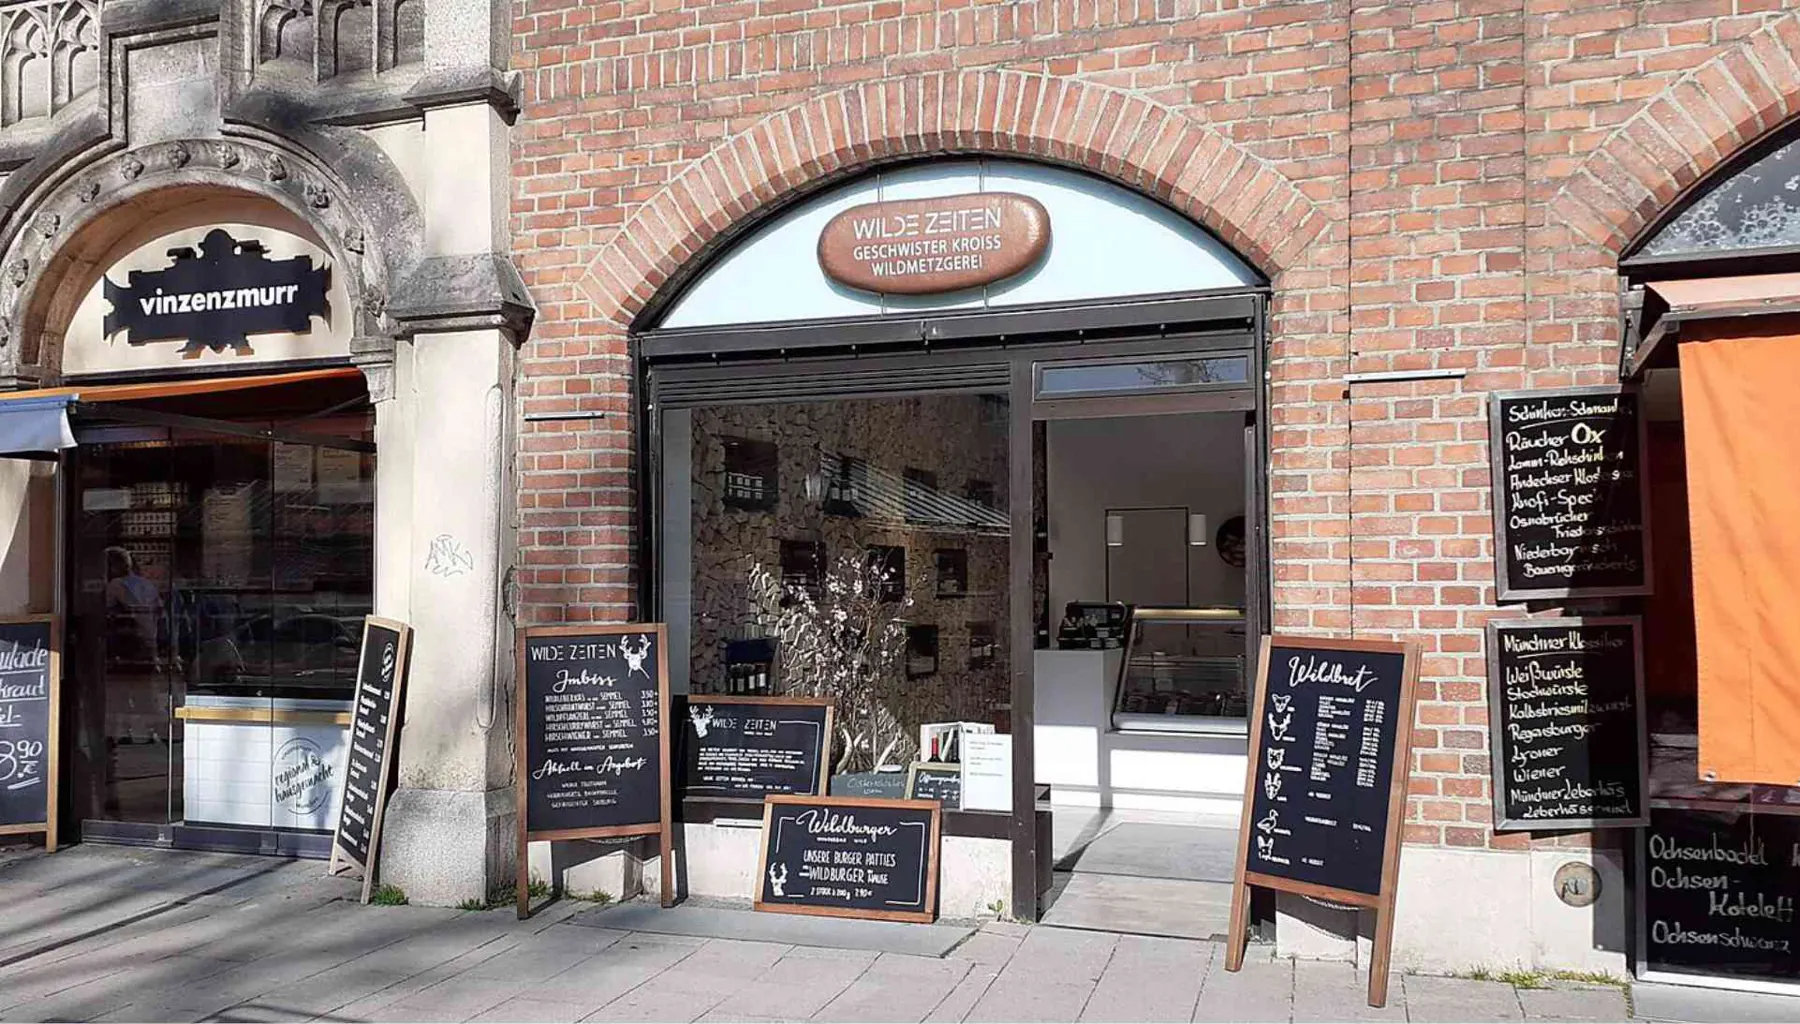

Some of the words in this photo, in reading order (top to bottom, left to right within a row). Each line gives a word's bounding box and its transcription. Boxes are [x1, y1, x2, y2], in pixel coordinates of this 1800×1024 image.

[853, 214, 920, 240] WILDE
[925, 207, 1001, 234] ZEITEN
[853, 240, 947, 261] GESCHWISTER
[952, 235, 1001, 252] KROISS
[871, 255, 983, 276] WILDMETZGEREI
[139, 284, 299, 316] vinzenzmurr
[1570, 422, 1606, 446] Ox
[531, 645, 565, 661] WILDE
[569, 643, 617, 661] ZEITEN
[1288, 655, 1379, 692] Wildbret
[1506, 660, 1583, 687] Weißwürste
[712, 717, 738, 729] WILDE
[744, 718, 777, 731] ZEITEN
[274, 753, 309, 786] regional
[596, 755, 647, 776] Angebot
[1513, 764, 1566, 783] Wiener
[796, 808, 898, 842] Wildburger
[803, 849, 830, 864] UNSERE
[834, 850, 862, 866] BURGER
[865, 852, 896, 868] PATTIES
[808, 865, 865, 883] WILDBURGER
[1708, 890, 1793, 923] Kotelett
